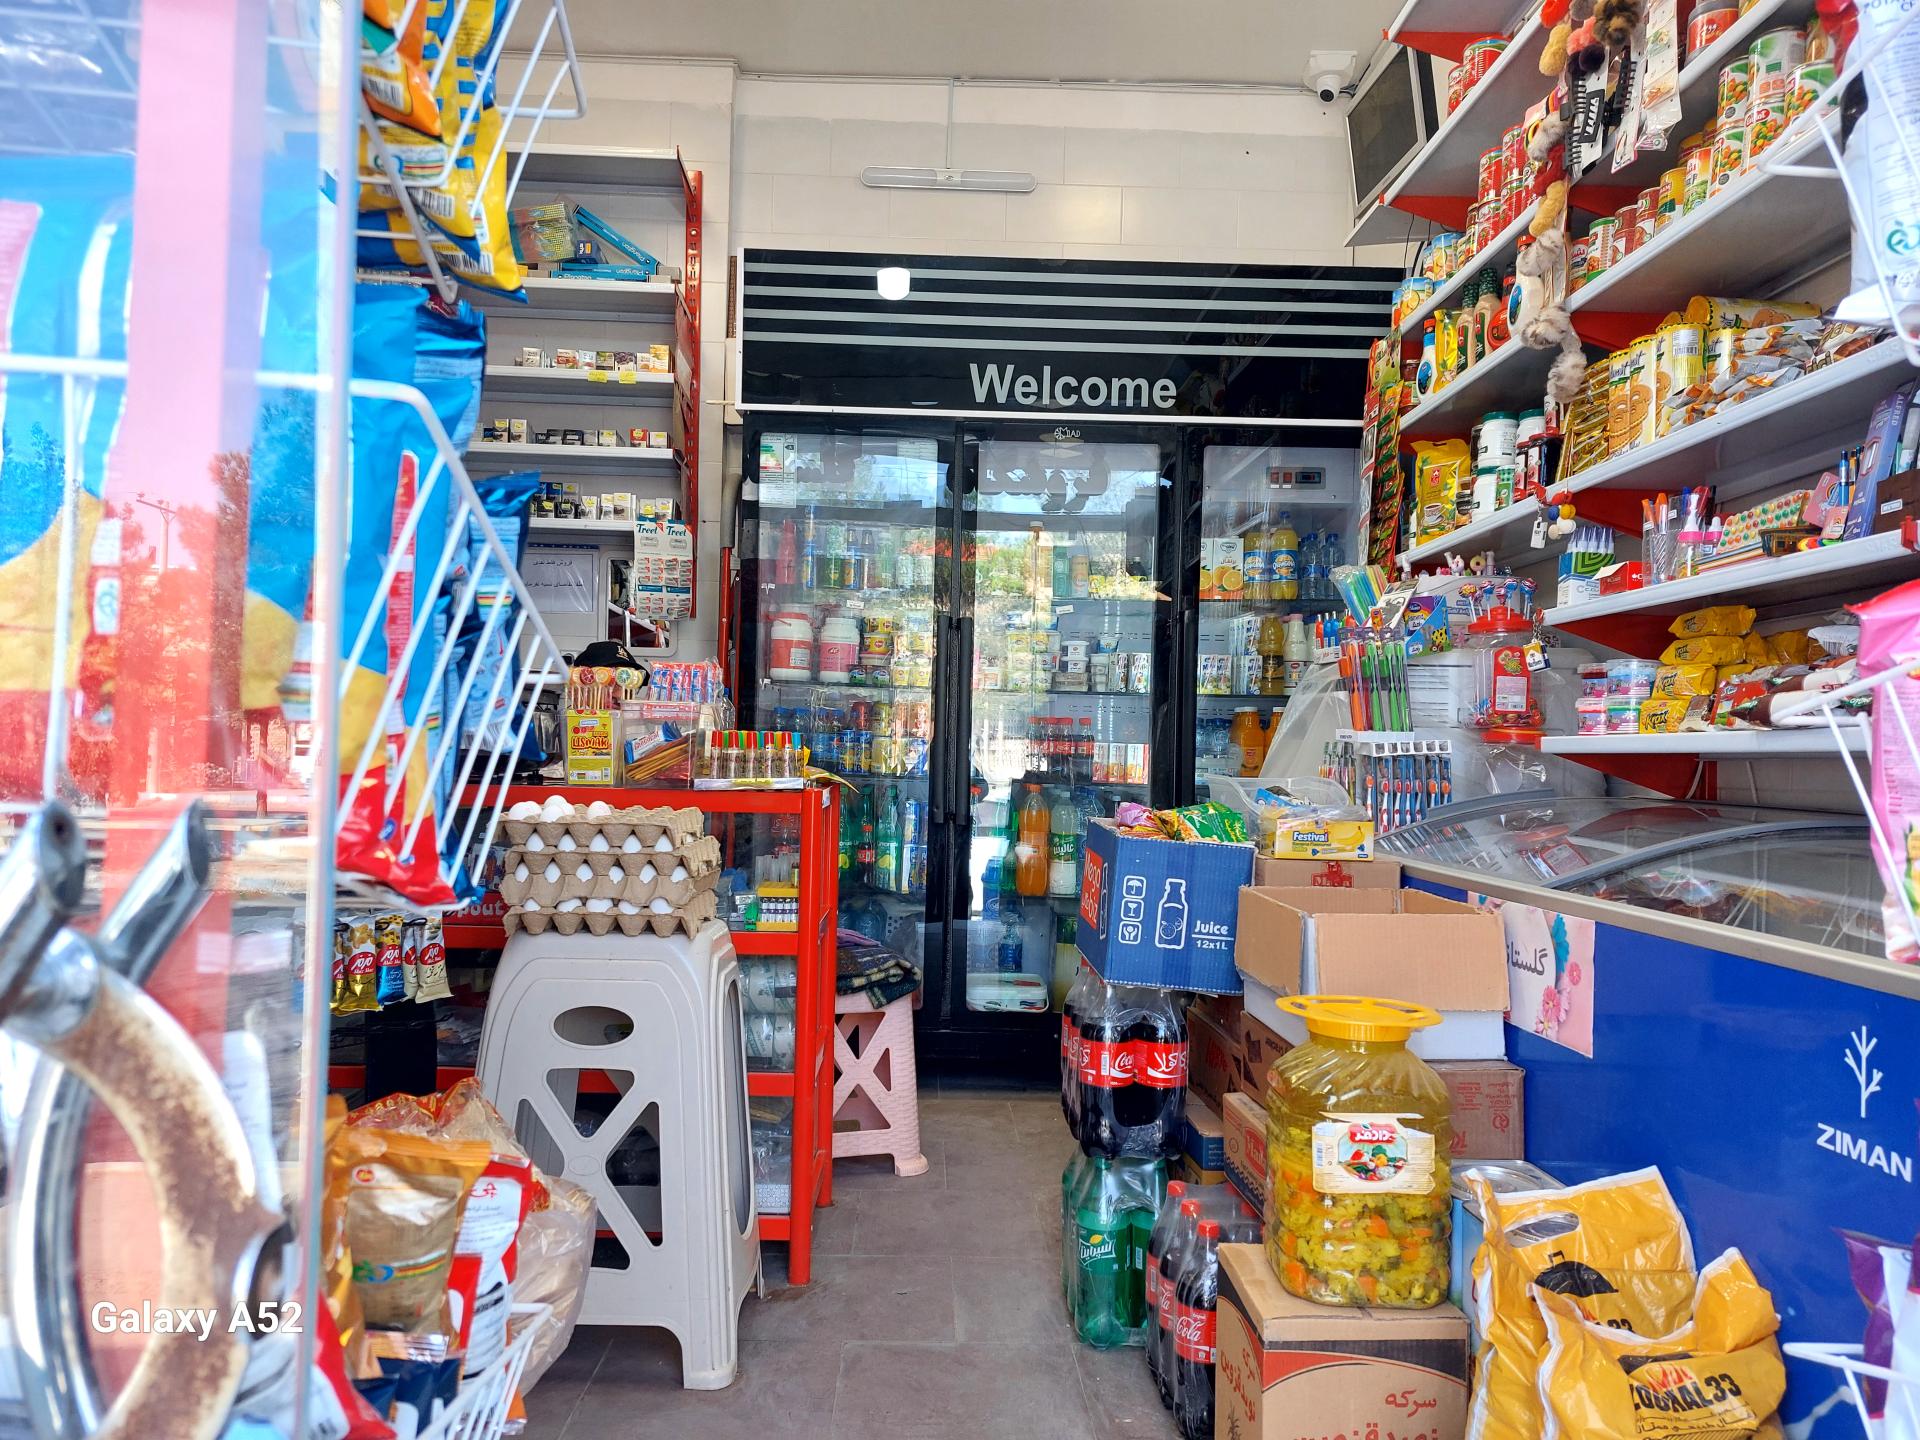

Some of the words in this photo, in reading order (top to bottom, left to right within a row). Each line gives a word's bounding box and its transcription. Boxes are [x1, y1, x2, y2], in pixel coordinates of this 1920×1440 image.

[969, 363, 1178, 409] Welcome
[1292, 830, 1329, 843] Festival
[1194, 920, 1229, 935] Juice
[1196, 940, 1228, 950] 12x1L
[1816, 1122, 1912, 1183] ZIMAN
[1176, 1316, 1205, 1342] Cola
[1385, 1390, 1437, 1418] سرکه
